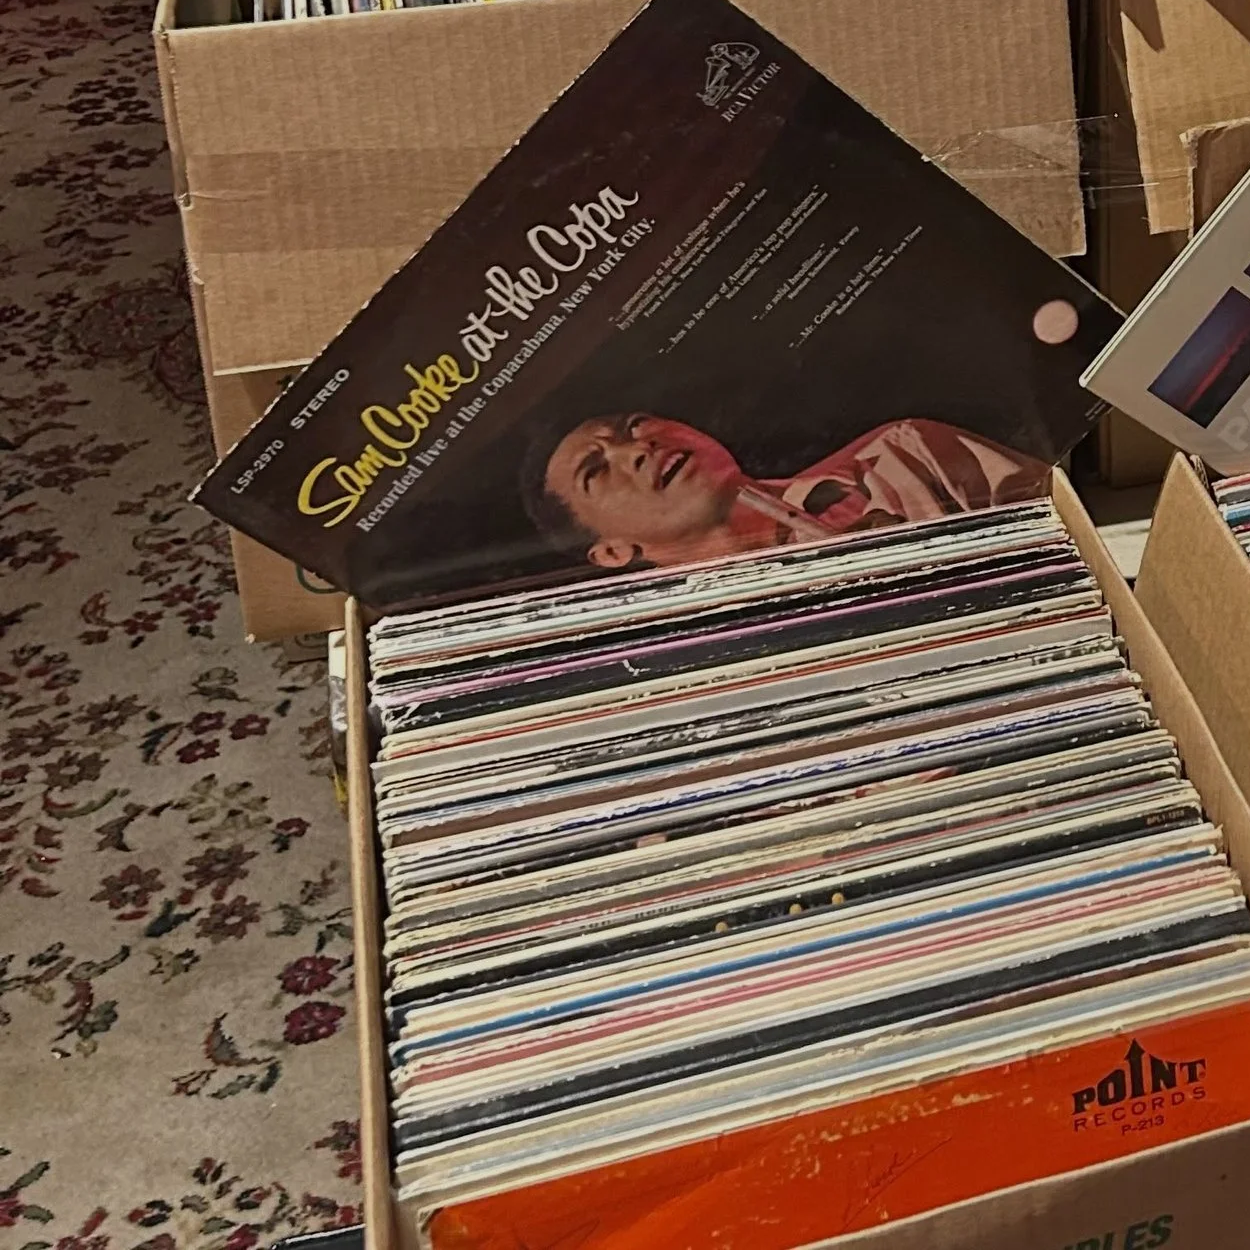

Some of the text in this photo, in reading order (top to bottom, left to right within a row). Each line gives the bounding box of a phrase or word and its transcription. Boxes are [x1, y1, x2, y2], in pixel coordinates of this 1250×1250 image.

[720, 101, 747, 122] RCA
[683, 316, 696, 330] to
[692, 306, 706, 320] be
[703, 292, 721, 310] one
[717, 282, 729, 294] of
[761, 230, 779, 249] top
[775, 216, 794, 236] pop
[812, 297, 839, 325] Cooke
[297, 186, 639, 527] Sam Cooke at the Copa
[356, 462, 425, 533] Recorded
[420, 436, 449, 467] live
[448, 419, 465, 440] at
[459, 396, 488, 425] the
[561, 280, 593, 313] New
[588, 247, 625, 282] York
[621, 216, 656, 250] City.
[289, 365, 352, 431] STEREO
[230, 436, 286, 495] LSP-2970
[1072, 1038, 1206, 1115] POINT
[1074, 1086, 1206, 1132] RECORDS
[1121, 1115, 1165, 1136] P-213
